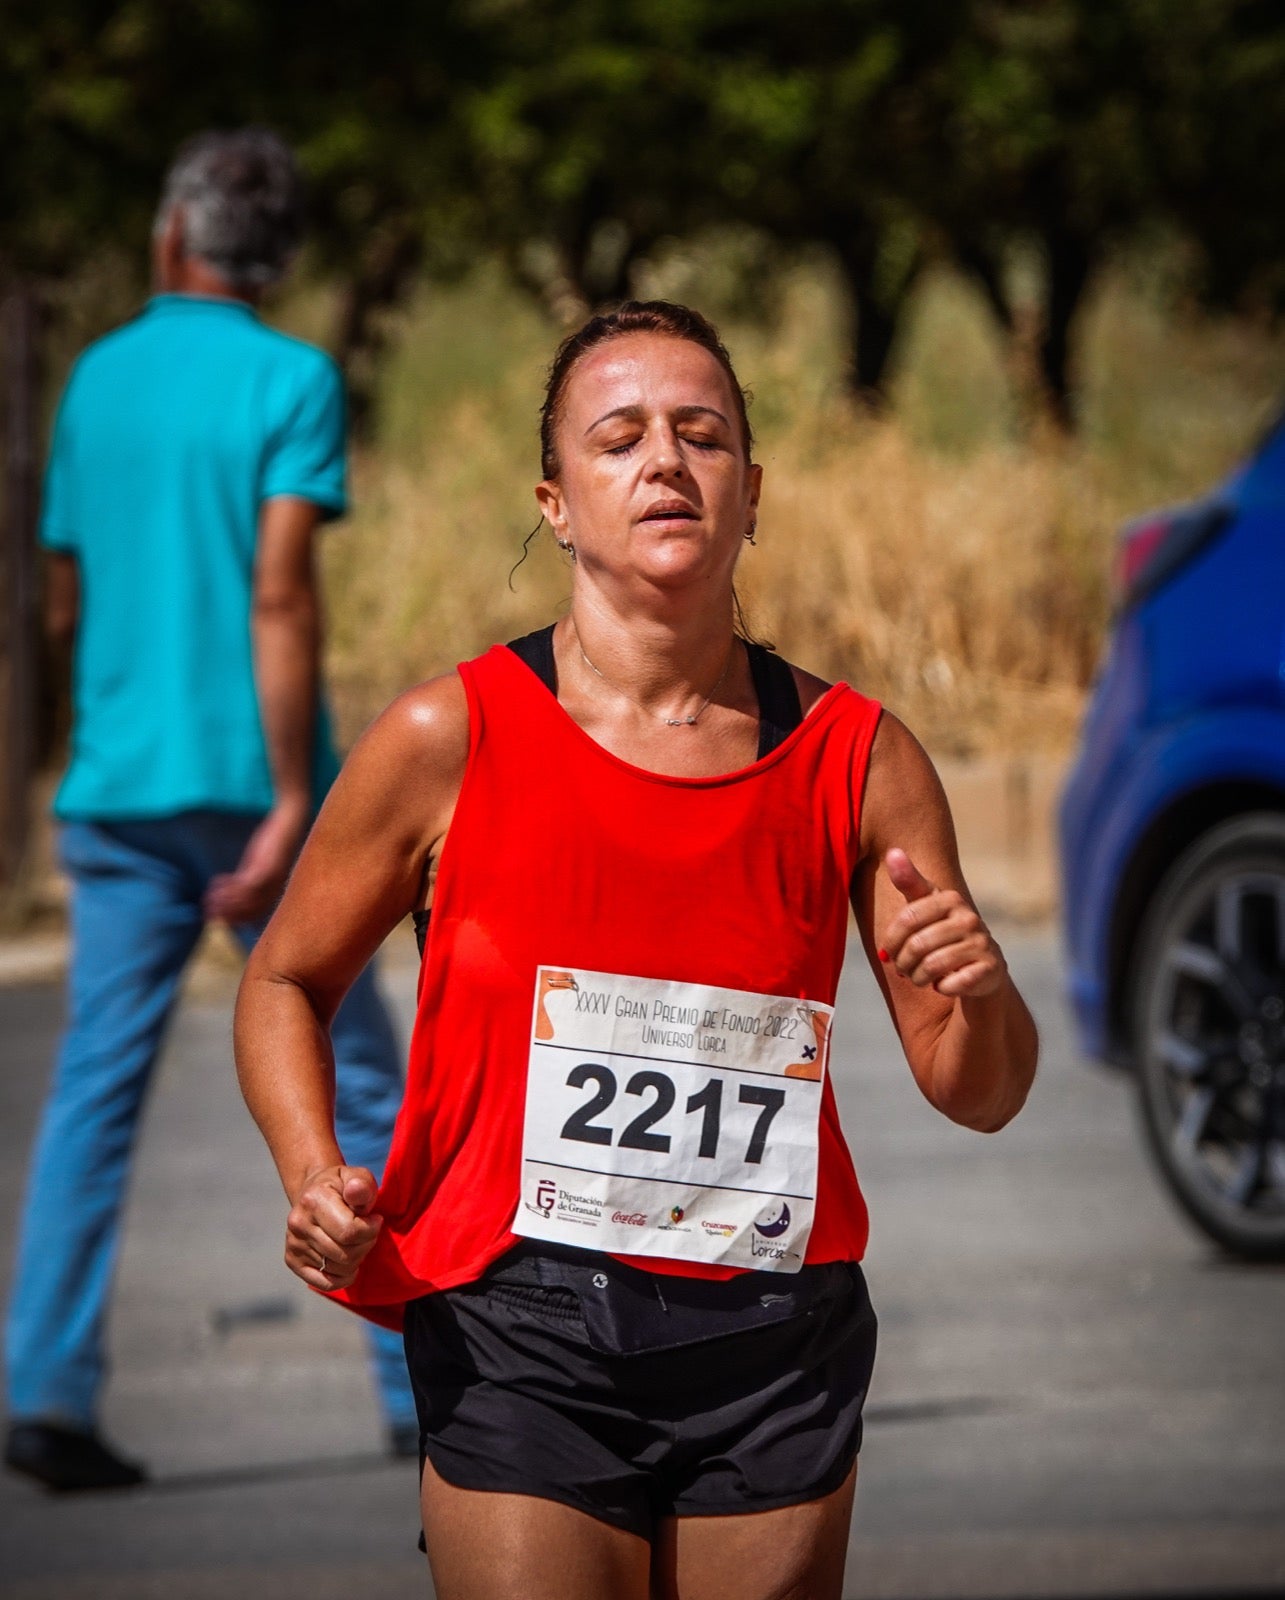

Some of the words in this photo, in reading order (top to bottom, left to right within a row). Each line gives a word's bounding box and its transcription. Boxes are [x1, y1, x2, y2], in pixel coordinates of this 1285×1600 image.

[575, 991, 611, 1014] XXXV
[763, 1015, 798, 1040] 2022
[560, 1063, 786, 1165] 2217
[559, 1190, 603, 1207] Diputación
[557, 1201, 568, 1211] de
[568, 1203, 602, 1217] Granada
[701, 1220, 738, 1231] Cruzcampo
